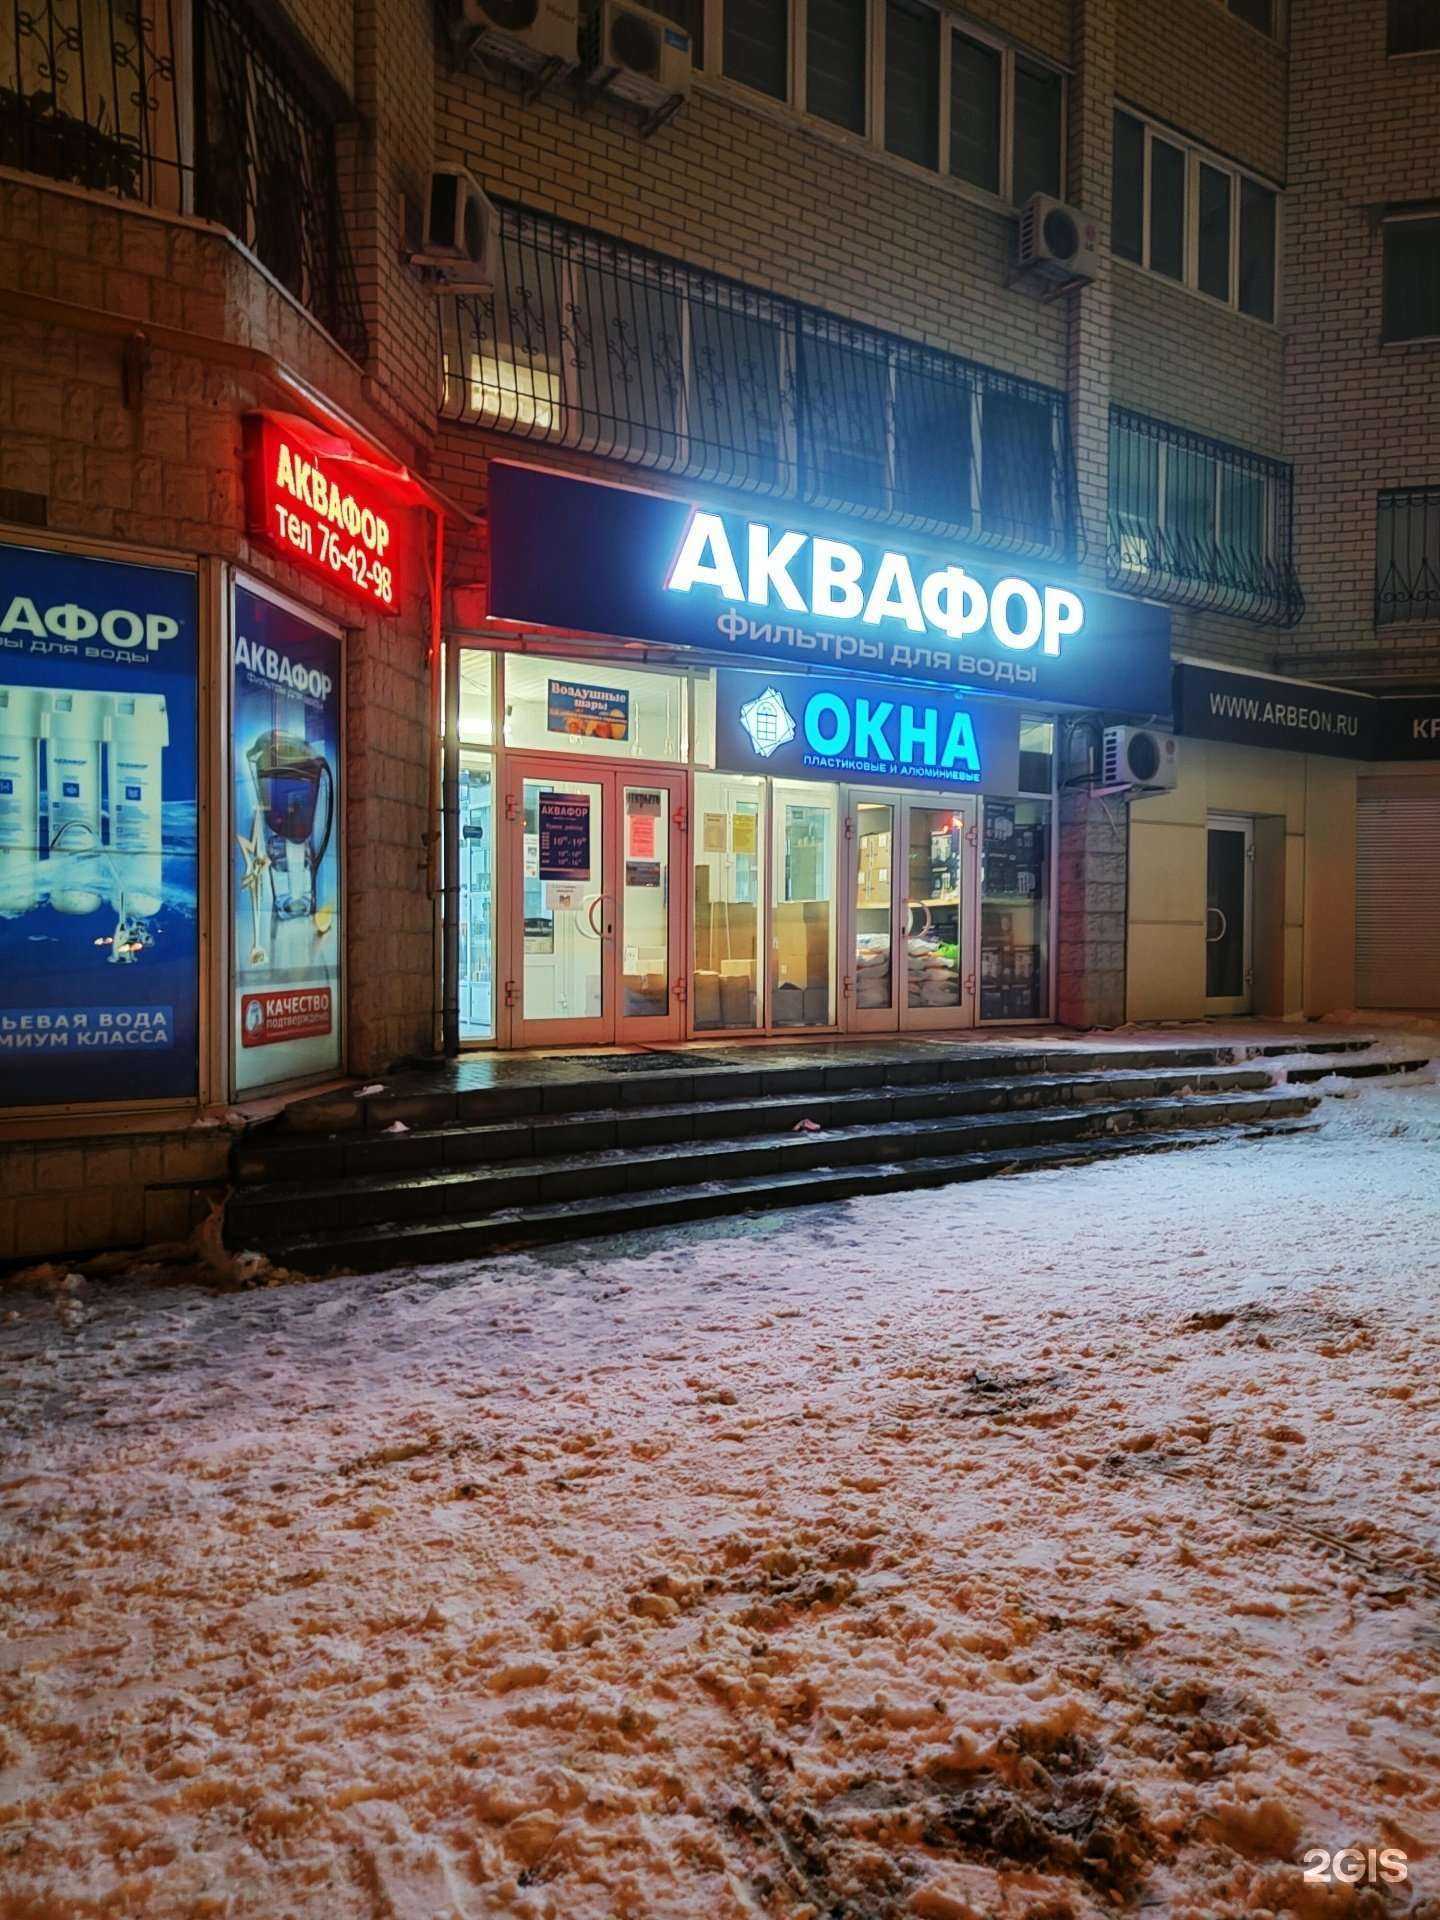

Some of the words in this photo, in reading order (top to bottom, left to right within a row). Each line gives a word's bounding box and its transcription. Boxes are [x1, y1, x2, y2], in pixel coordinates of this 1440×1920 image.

[276, 443, 389, 556] АКВАФОР
[318, 521, 393, 603] 76-42-98
[667, 510, 1085, 656] АКВАФОР
[30, 640, 78, 655] для
[85, 646, 149, 664] воды
[235, 636, 332, 701] АКВАФОР
[716, 608, 885, 661] фильтры
[890, 645, 951, 671] для
[957, 656, 1037, 684] воды
[804, 692, 981, 770] ОКНА
[1209, 692, 1359, 737] WWW.ARBEON.RU
[803, 755, 887, 773] ПЛАСТИКОВЫЕ
[890, 764, 897, 774] И
[901, 766, 981, 782] АЛЮМИНИЕВЫЕ
[541, 805, 589, 817] АКВАФОР
[99, 1011, 167, 1028] ВОДА
[266, 994, 329, 1017] КАЧЕСТВО
[77, 1030, 168, 1045] КЛАССА
